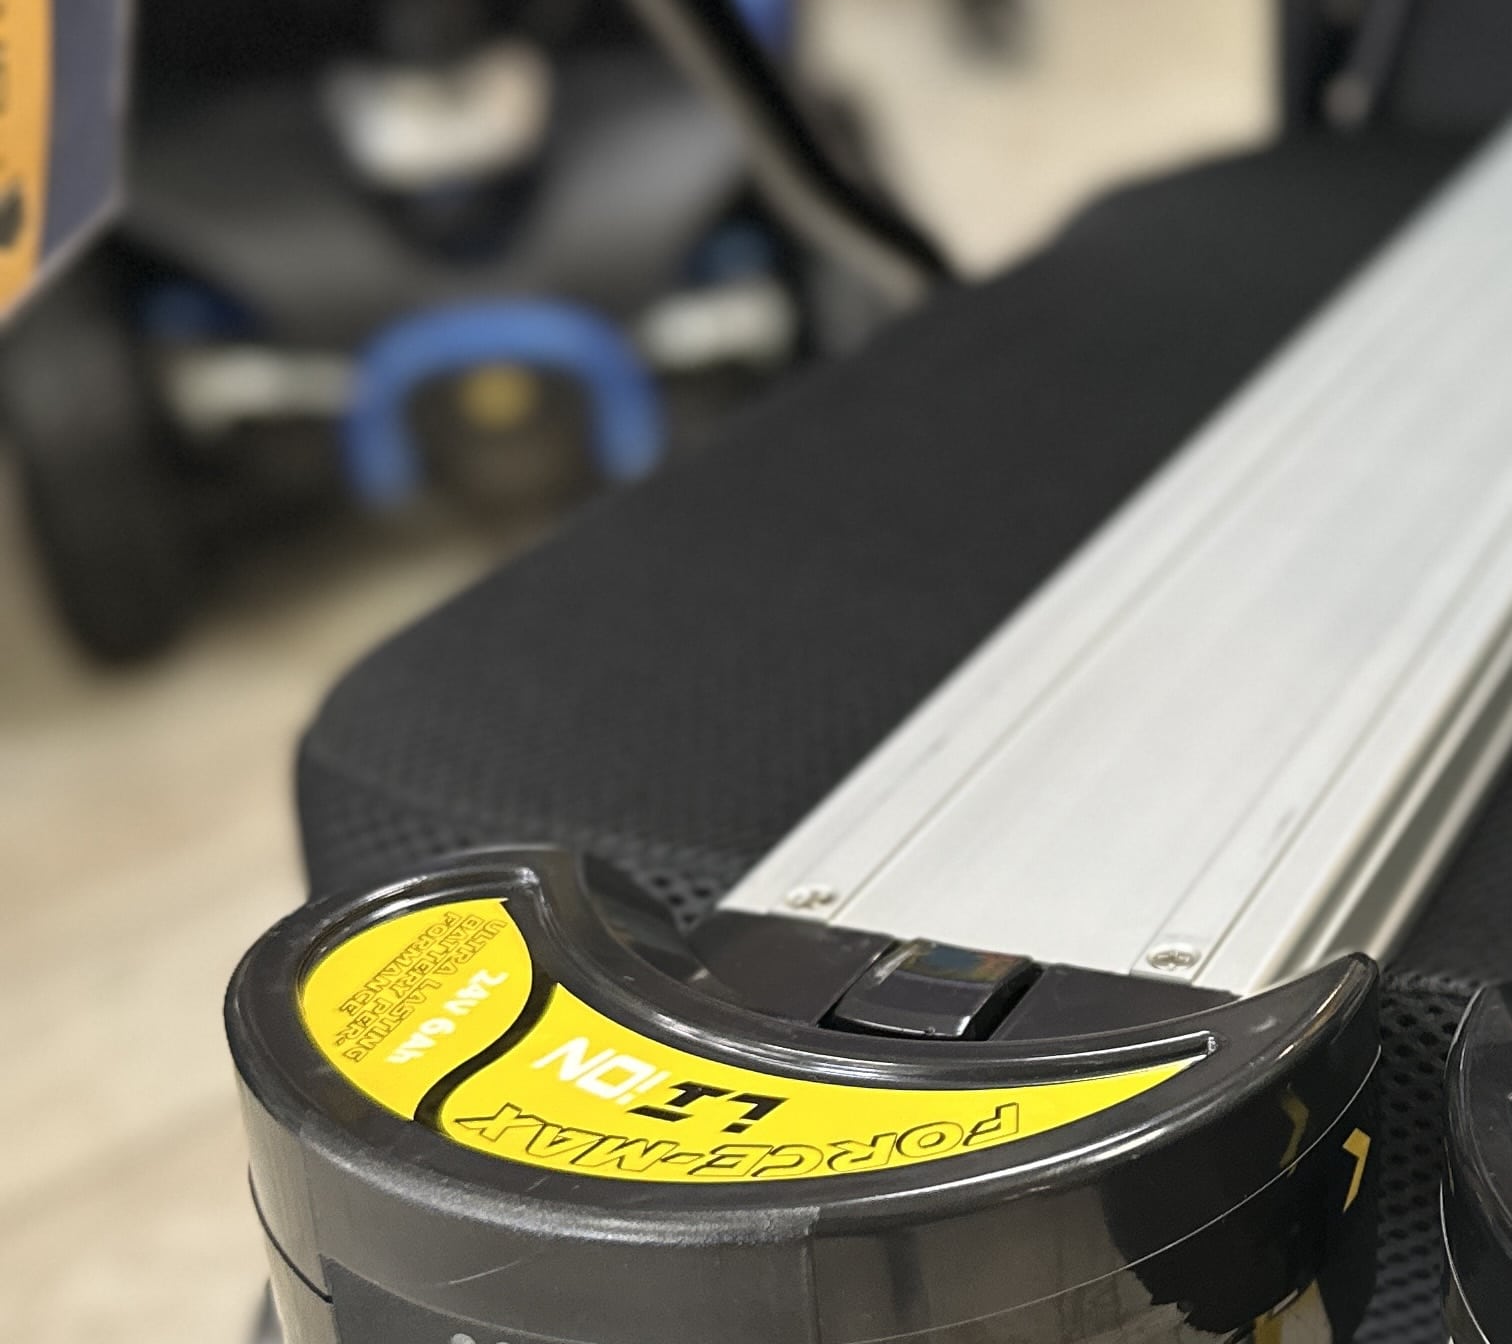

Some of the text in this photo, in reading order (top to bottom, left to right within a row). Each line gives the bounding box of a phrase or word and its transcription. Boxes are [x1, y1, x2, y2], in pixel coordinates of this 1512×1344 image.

[338, 911, 461, 1016] FORMANCE
[342, 919, 507, 1063] ULTRA LASTING
[390, 915, 484, 999] BATTERY
[384, 968, 509, 1065] 24V 6Ah
[454, 1102, 1019, 1178] FORCE-MAX
